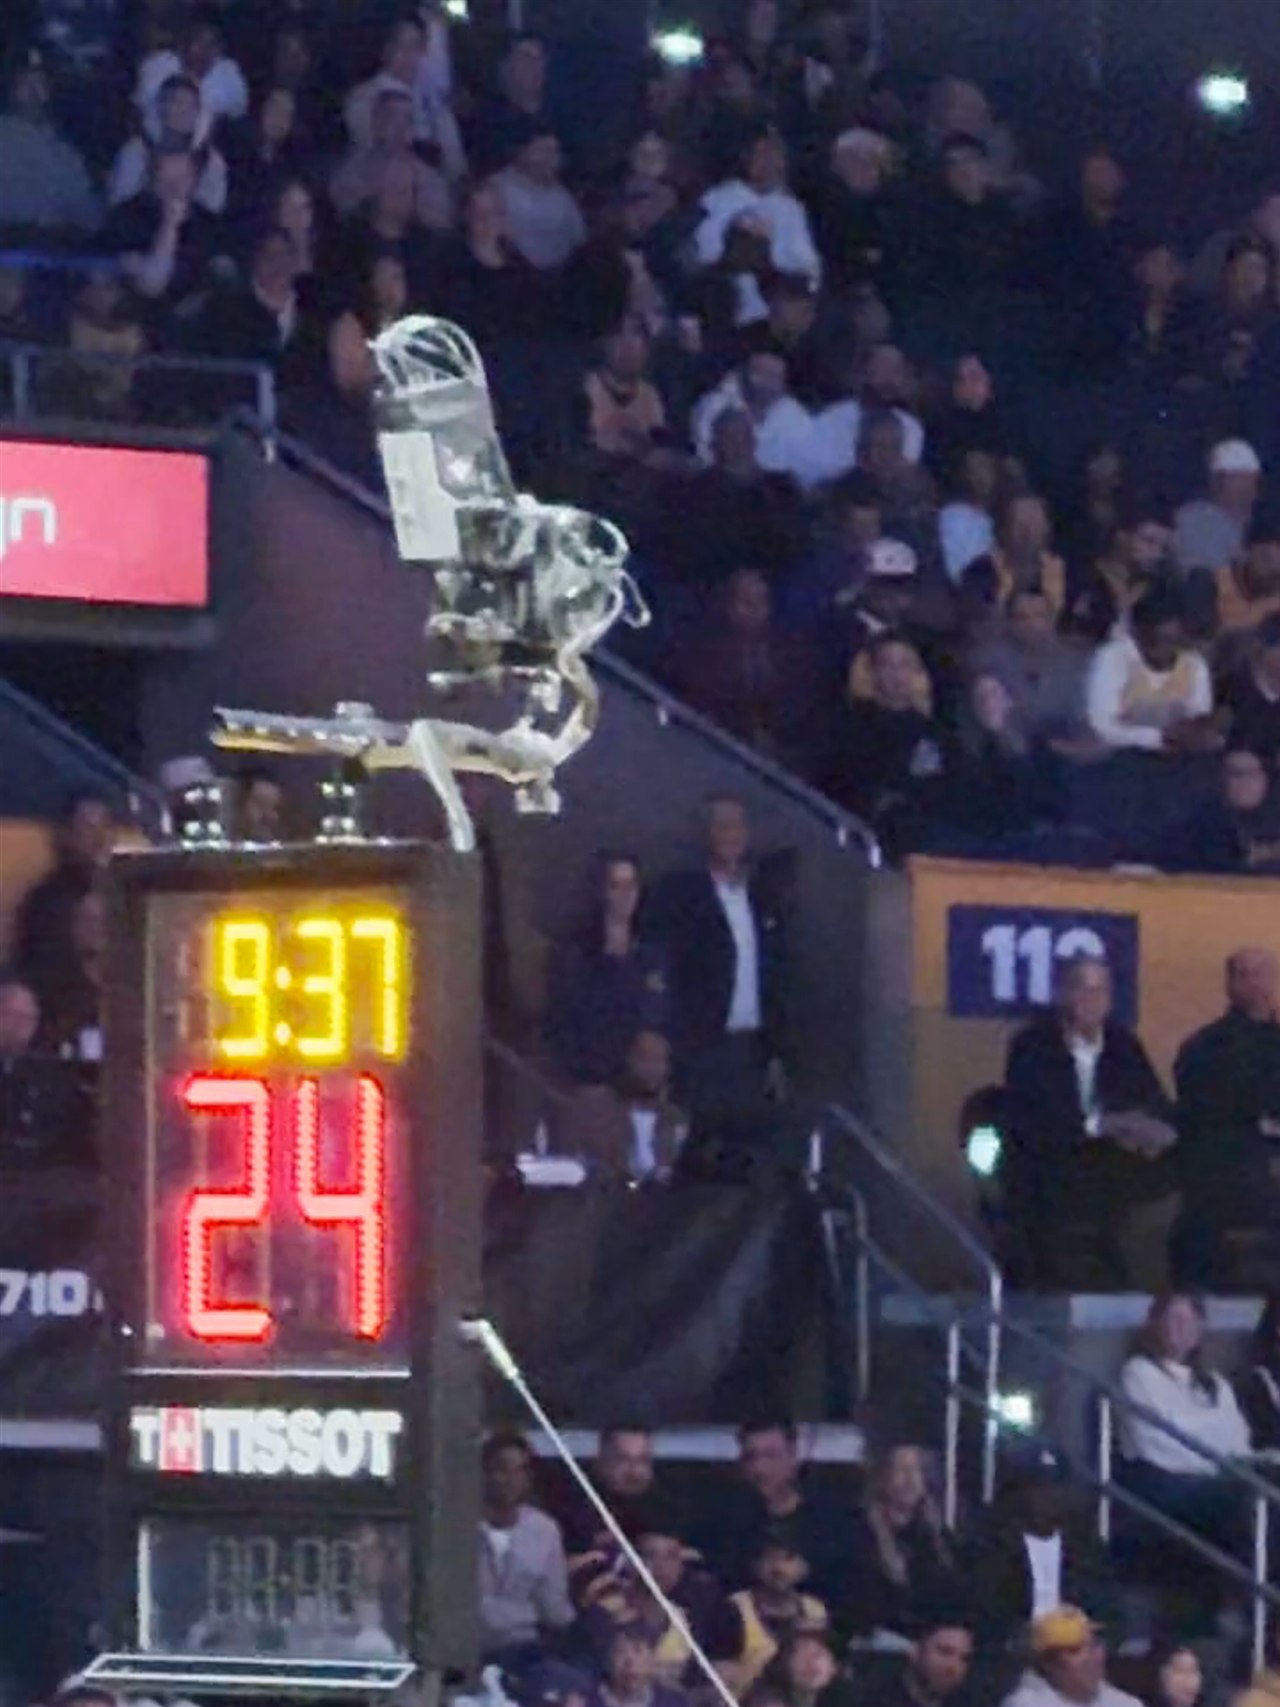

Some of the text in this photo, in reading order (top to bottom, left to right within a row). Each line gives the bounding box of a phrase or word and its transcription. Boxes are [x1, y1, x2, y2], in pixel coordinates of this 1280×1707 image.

[0, 496, 57, 560] n
[221, 918, 398, 1058] 9:37
[184, 1071, 384, 1342] 24
[202, 1409, 402, 1479] TISSOT
